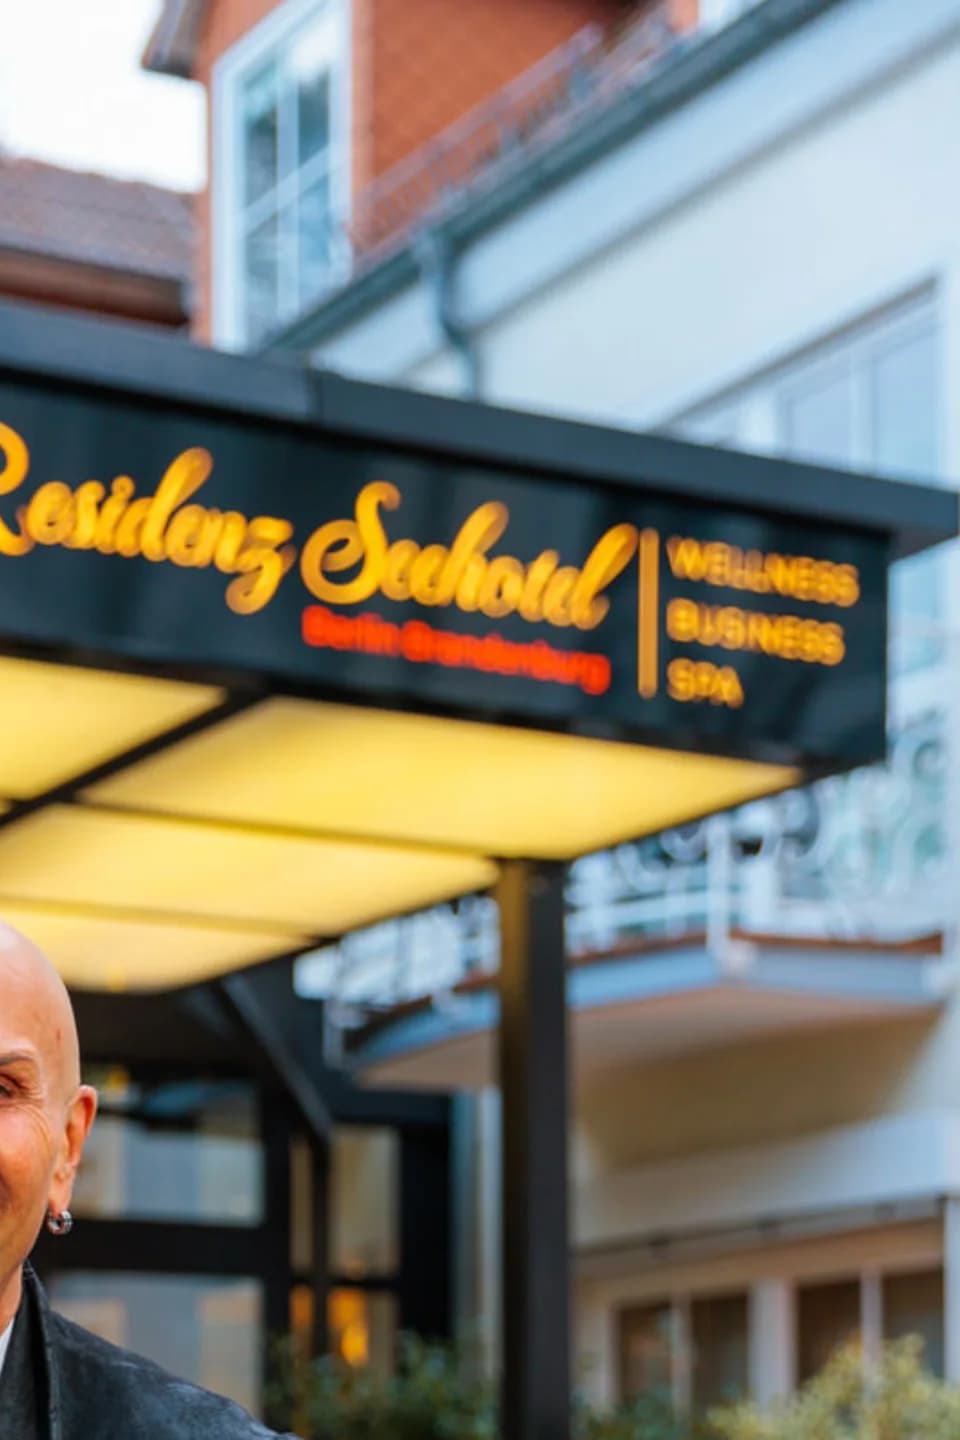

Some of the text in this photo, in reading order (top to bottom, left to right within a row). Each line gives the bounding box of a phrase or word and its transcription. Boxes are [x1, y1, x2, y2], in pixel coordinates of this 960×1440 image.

[300, 481, 638, 631] Seehotel
[667, 537, 859, 608] WELLNESS
[667, 598, 846, 667] BUSINESS
[667, 658, 744, 709] SPA
